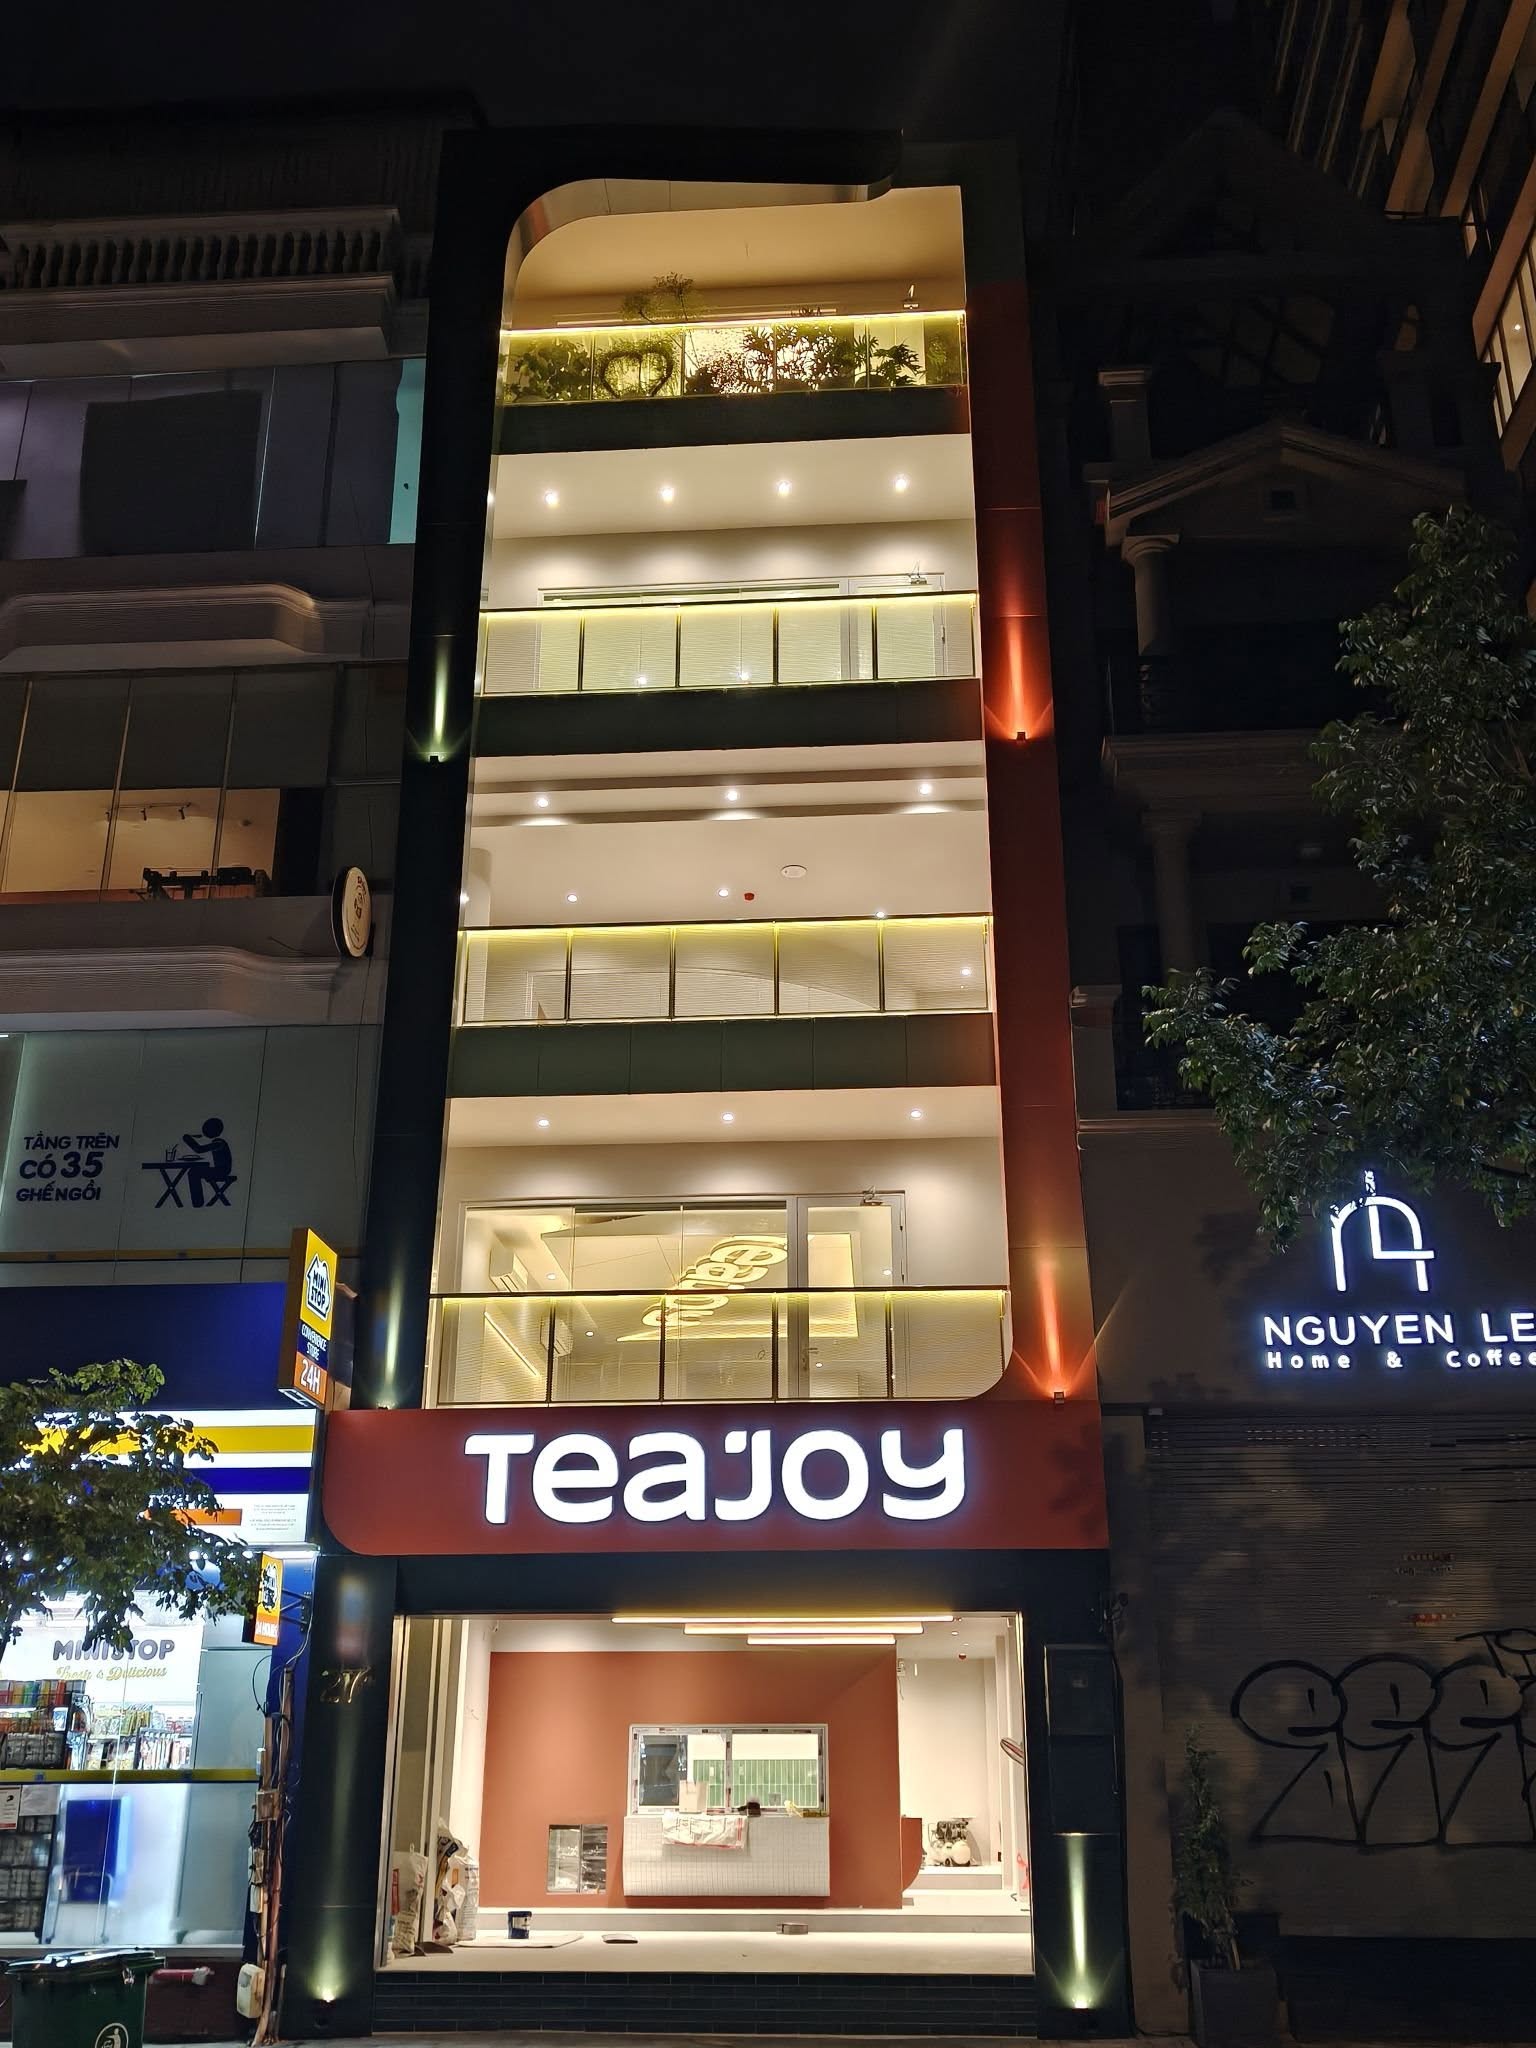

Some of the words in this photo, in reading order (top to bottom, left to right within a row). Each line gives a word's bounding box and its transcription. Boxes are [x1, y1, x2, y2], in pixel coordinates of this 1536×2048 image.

[77, 1132, 120, 1149] TRÊN
[19, 1153, 57, 1180] CÓ
[60, 1151, 104, 1179] 35
[16, 1180, 56, 1202] GHẾ
[55, 1179, 101, 1201] NGỒI
[310, 1285, 326, 1309] STOP
[1264, 1314, 1454, 1346] NGUYEN
[1481, 1312, 1536, 1343] LE
[1267, 1352, 1351, 1369] Home
[1387, 1351, 1403, 1369] &
[1446, 1349, 1536, 1368] Coffee
[300, 1358, 321, 1395] 24H
